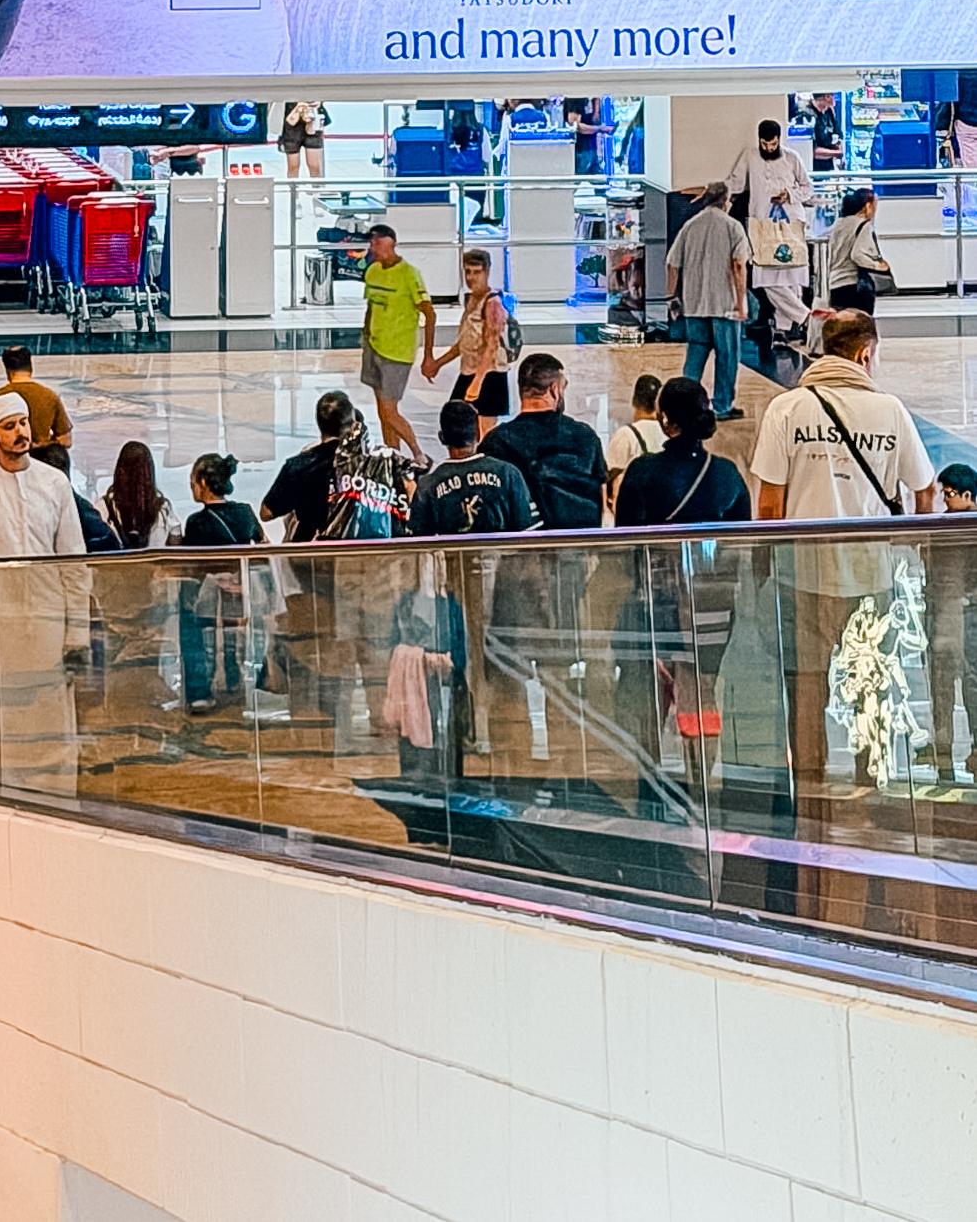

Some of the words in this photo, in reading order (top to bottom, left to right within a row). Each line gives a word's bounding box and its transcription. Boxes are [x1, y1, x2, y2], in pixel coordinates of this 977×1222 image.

[385, 18, 465, 60] and
[481, 28, 599, 68] many
[614, 14, 736, 57] more!
[222, 100, 257, 134] G
[794, 425, 896, 452] ALLSINTS
